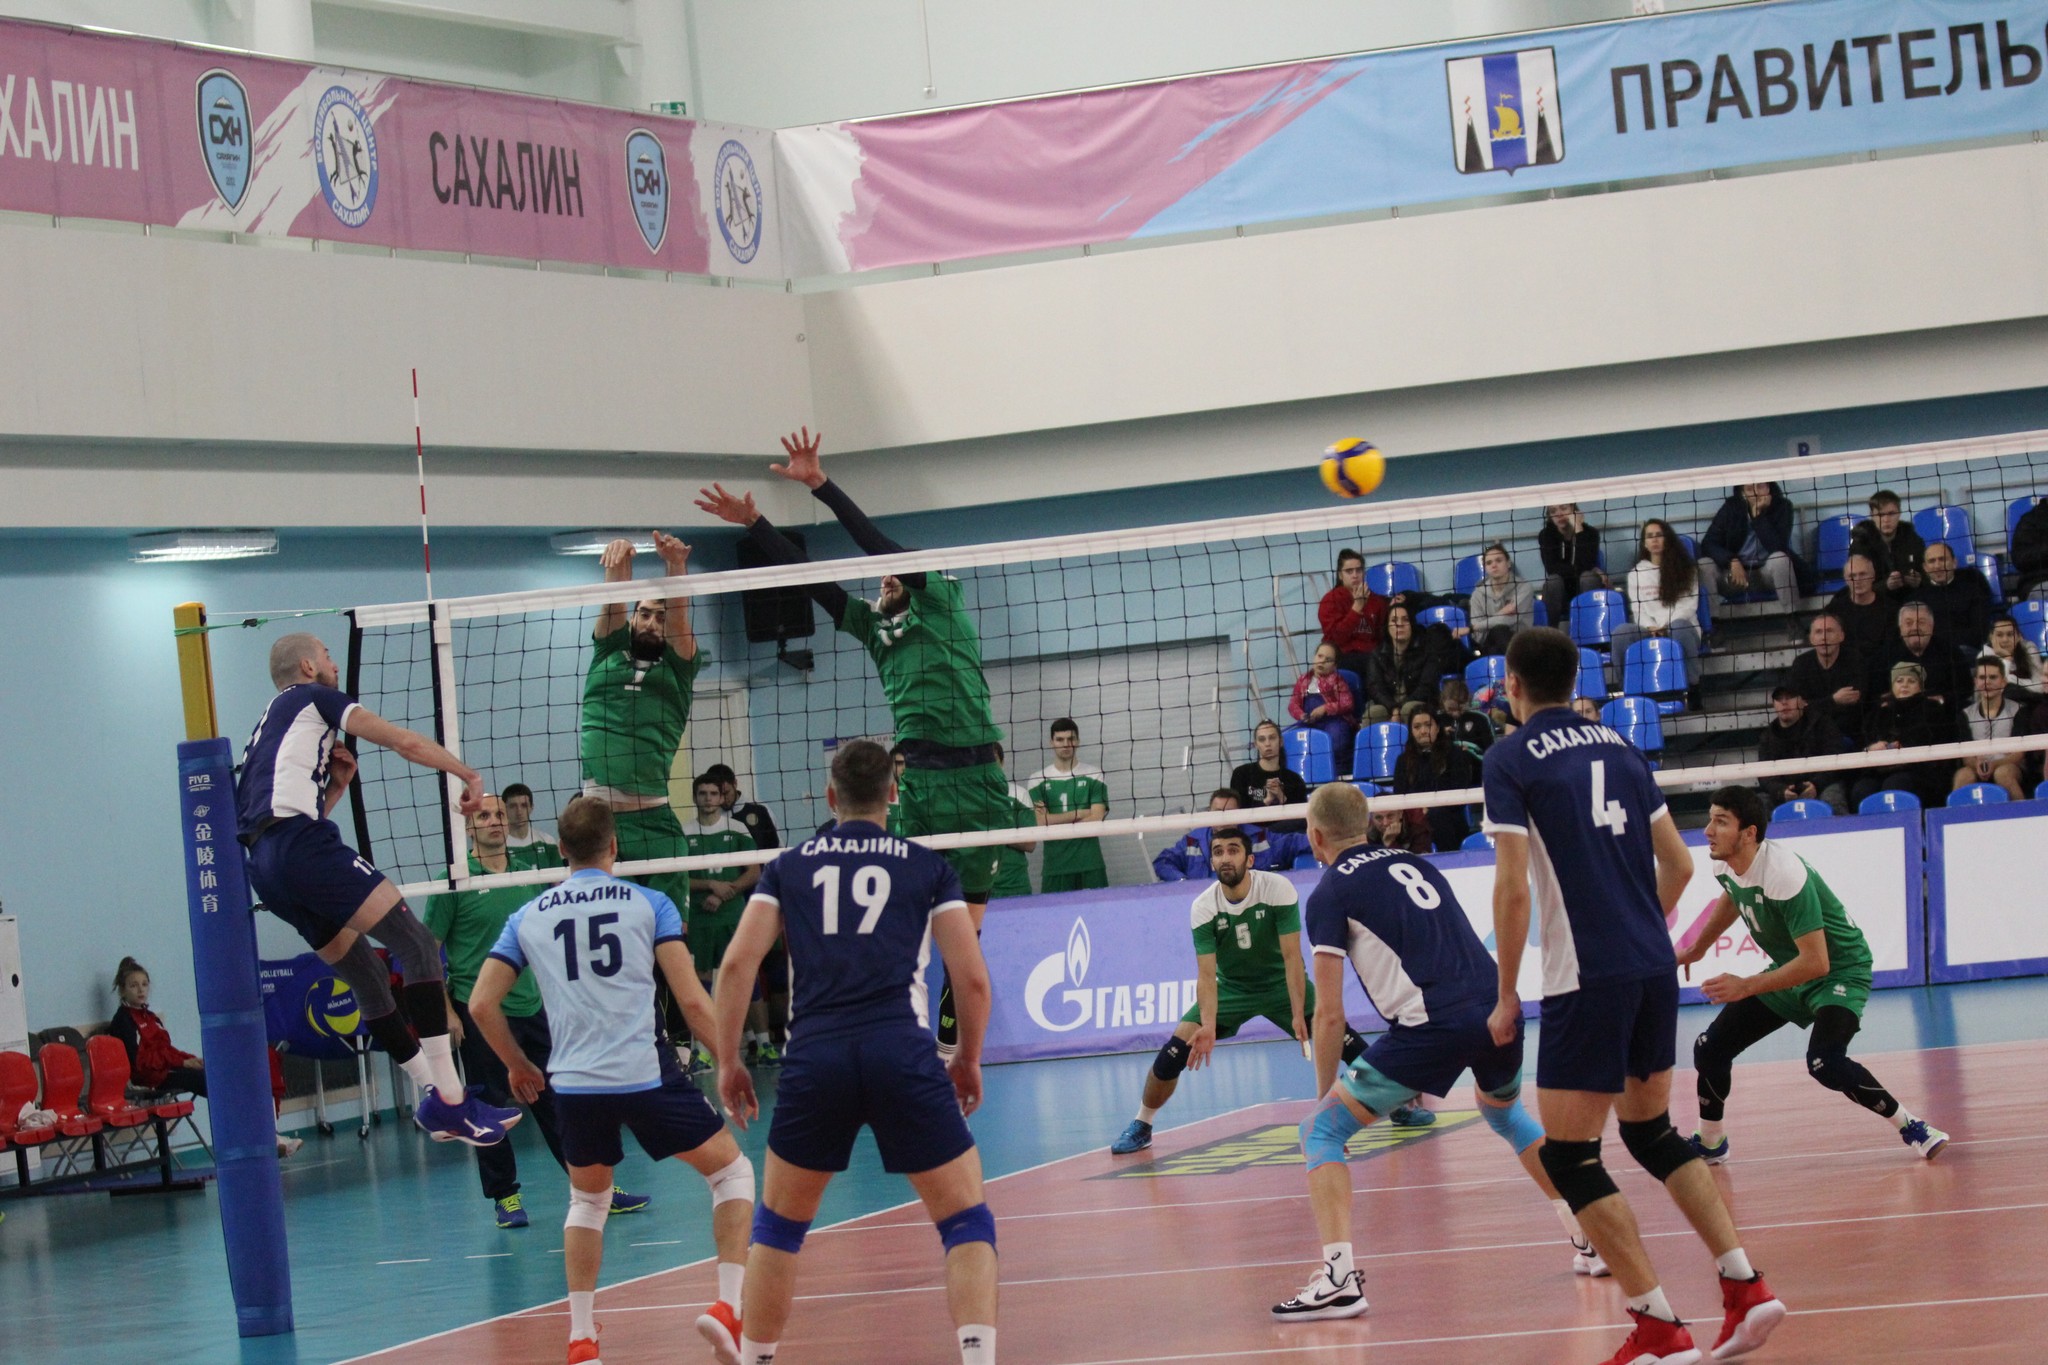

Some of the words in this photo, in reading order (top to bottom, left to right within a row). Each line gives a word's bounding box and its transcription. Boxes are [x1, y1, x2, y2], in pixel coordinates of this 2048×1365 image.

[1610, 19, 2048, 134] ПРАВИТЕЛЬ
[429, 131, 584, 217] САХАЛИН
[331, 200, 370, 227] САХАЛИН
[1527, 725, 1628, 759] САХАЛИН
[1591, 760, 1628, 835] 4
[195, 823, 219, 913] 金陵体育
[801, 836, 908, 859] САХАЛИН
[538, 886, 631, 911] САХАЛИН
[812, 865, 891, 935] 19
[1388, 863, 1441, 910] 8
[554, 912, 623, 981] 15
[1235, 922, 1252, 949] 5
[1096, 979, 1198, 1028] ГАЗПР
